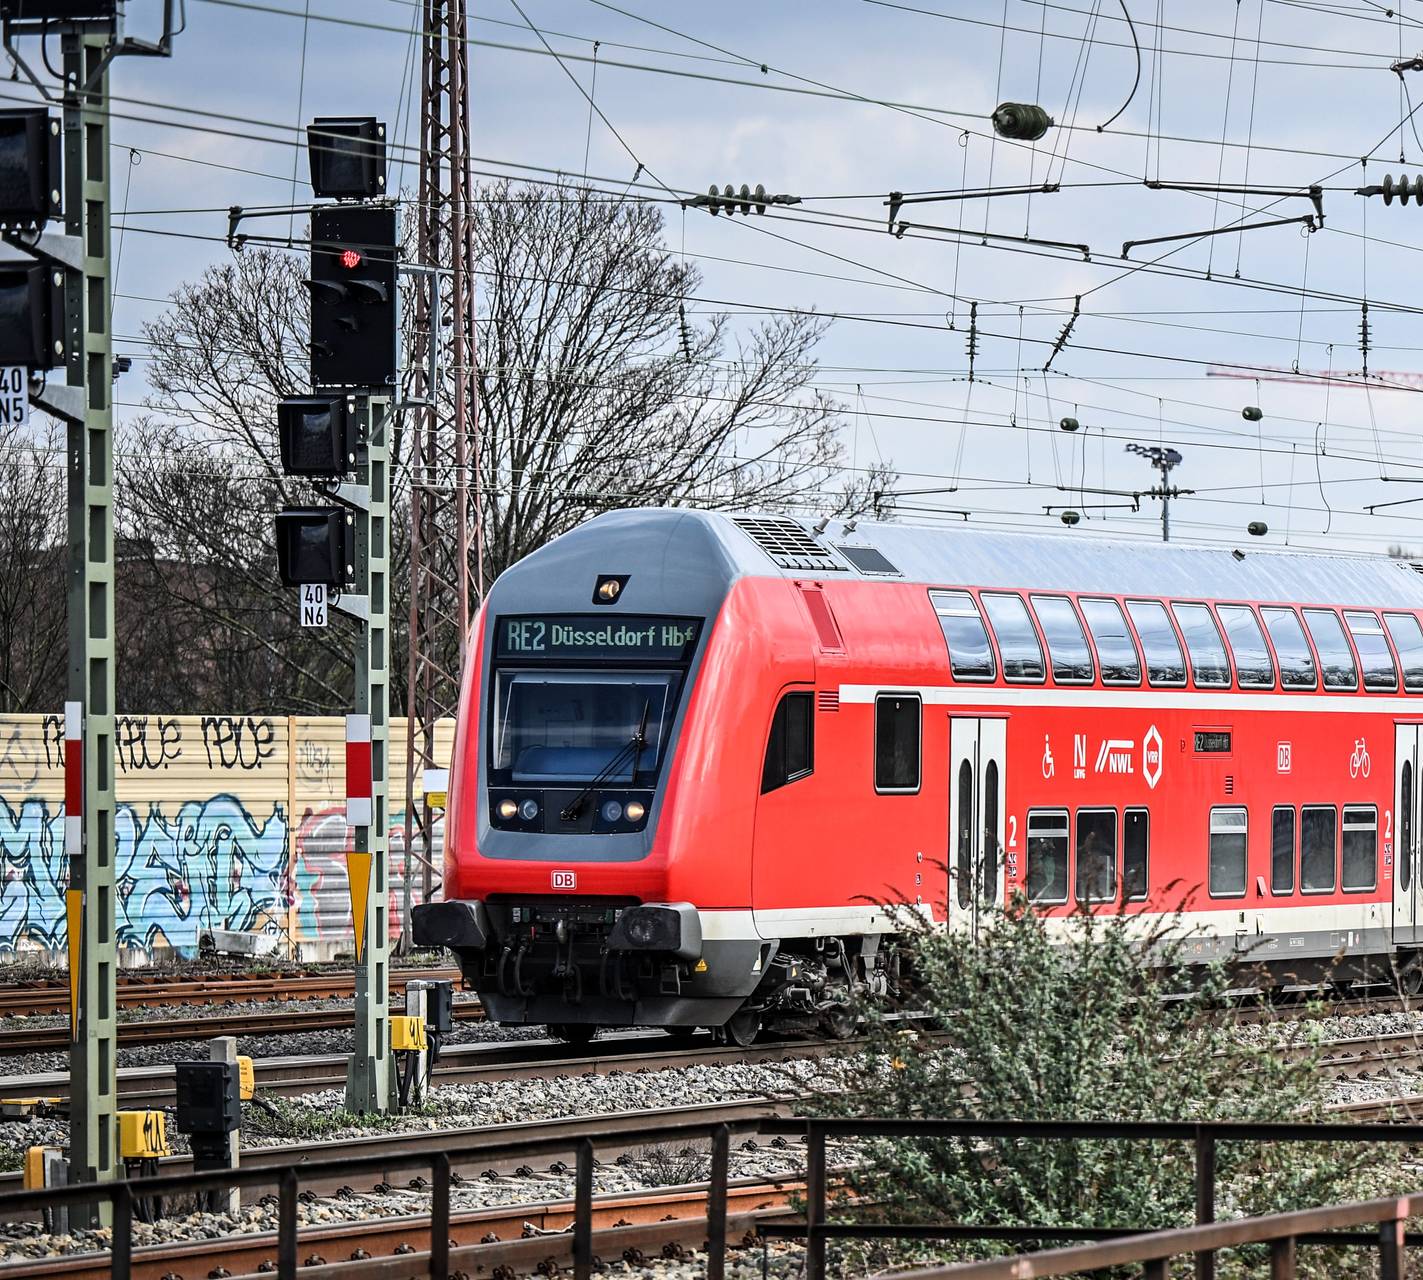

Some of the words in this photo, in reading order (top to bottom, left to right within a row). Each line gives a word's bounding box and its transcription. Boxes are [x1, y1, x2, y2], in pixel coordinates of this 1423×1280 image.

[0, 368, 21, 393] 40
[0, 397, 23, 422] N5
[305, 585, 323, 603] 40
[305, 606, 323, 625] N6
[507, 621, 545, 651] RE2
[551, 625, 656, 646] Düsseldorf
[1109, 753, 1134, 773] NWL
[1279, 745, 1291, 770] DB
[1008, 815, 1017, 847] 2
[1384, 810, 1392, 839] 2
[553, 872, 575, 888] DB
